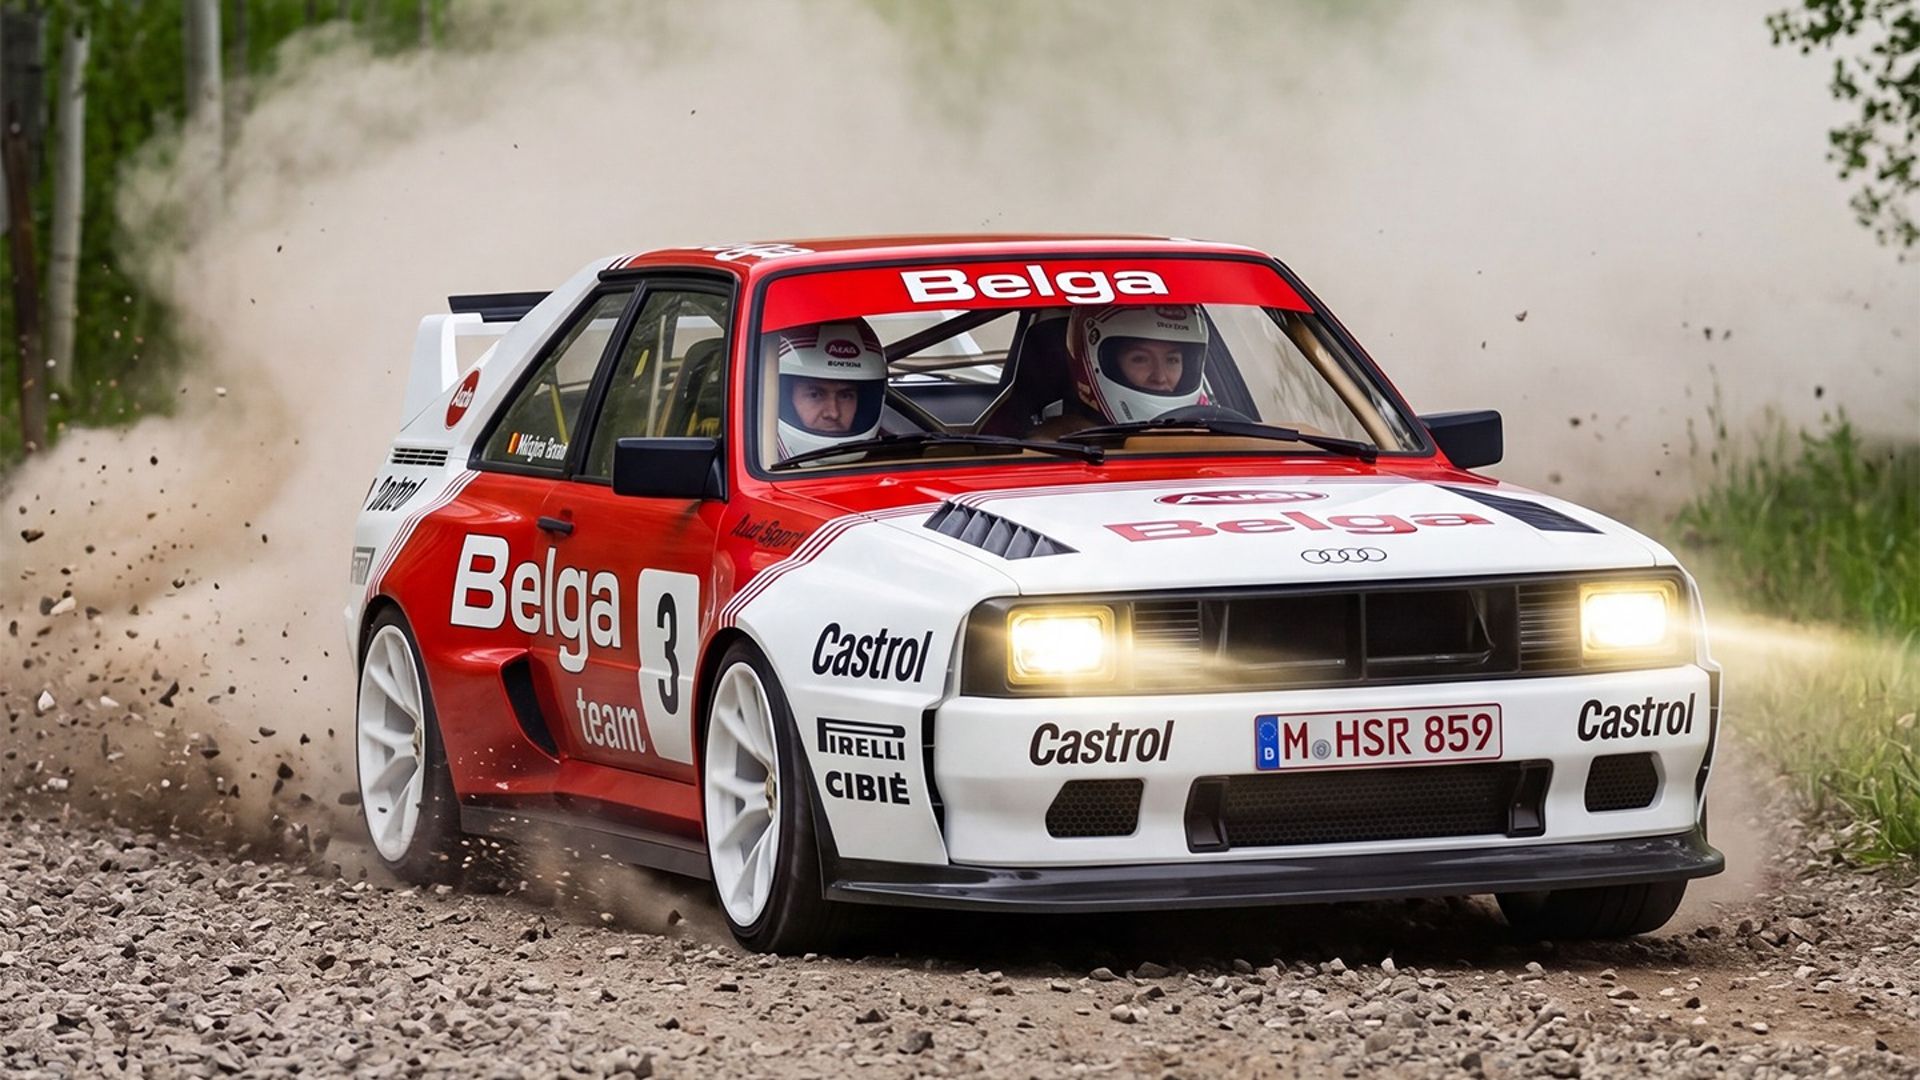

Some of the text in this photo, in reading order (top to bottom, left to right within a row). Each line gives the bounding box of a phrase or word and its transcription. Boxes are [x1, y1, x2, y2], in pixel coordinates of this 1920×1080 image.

[900, 264, 1169, 305] Belga
[1102, 511, 1495, 542] Belga
[450, 533, 622, 674] Belga
[656, 592, 680, 716] 3
[812, 622, 934, 683] Castrol
[576, 687, 646, 754] team
[816, 717, 906, 761] PIRELLI
[1283, 713, 1493, 760] M HSR 859
[1578, 692, 1696, 742] Castrol
[1029, 719, 1175, 766] Castrol
[1264, 747, 1275, 761] B
